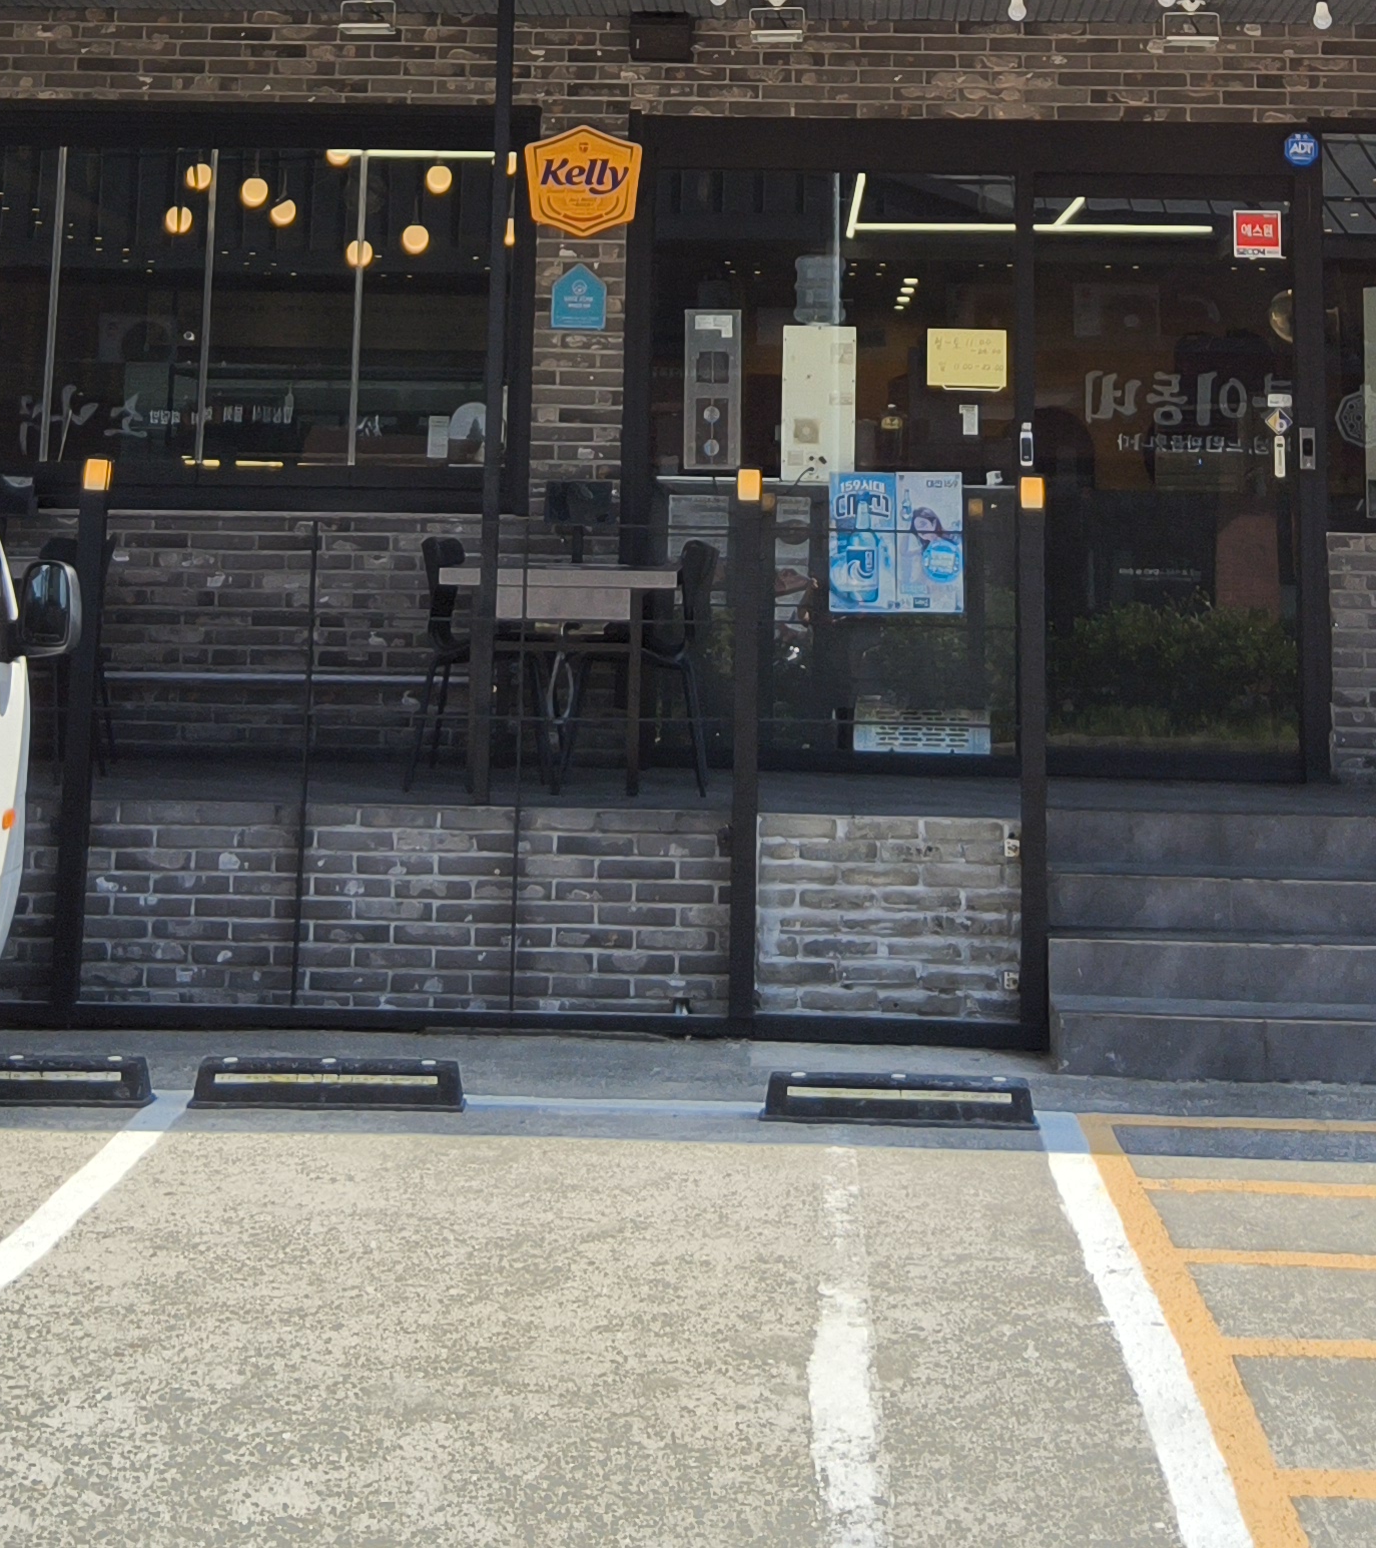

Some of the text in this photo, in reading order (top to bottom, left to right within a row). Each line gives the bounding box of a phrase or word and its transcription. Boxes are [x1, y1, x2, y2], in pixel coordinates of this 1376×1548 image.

[1289, 141, 1314, 154] ADT
[539, 156, 630, 196] Kelly
[1240, 223, 1274, 239] 에스원
[839, 479, 886, 494] 159시대
